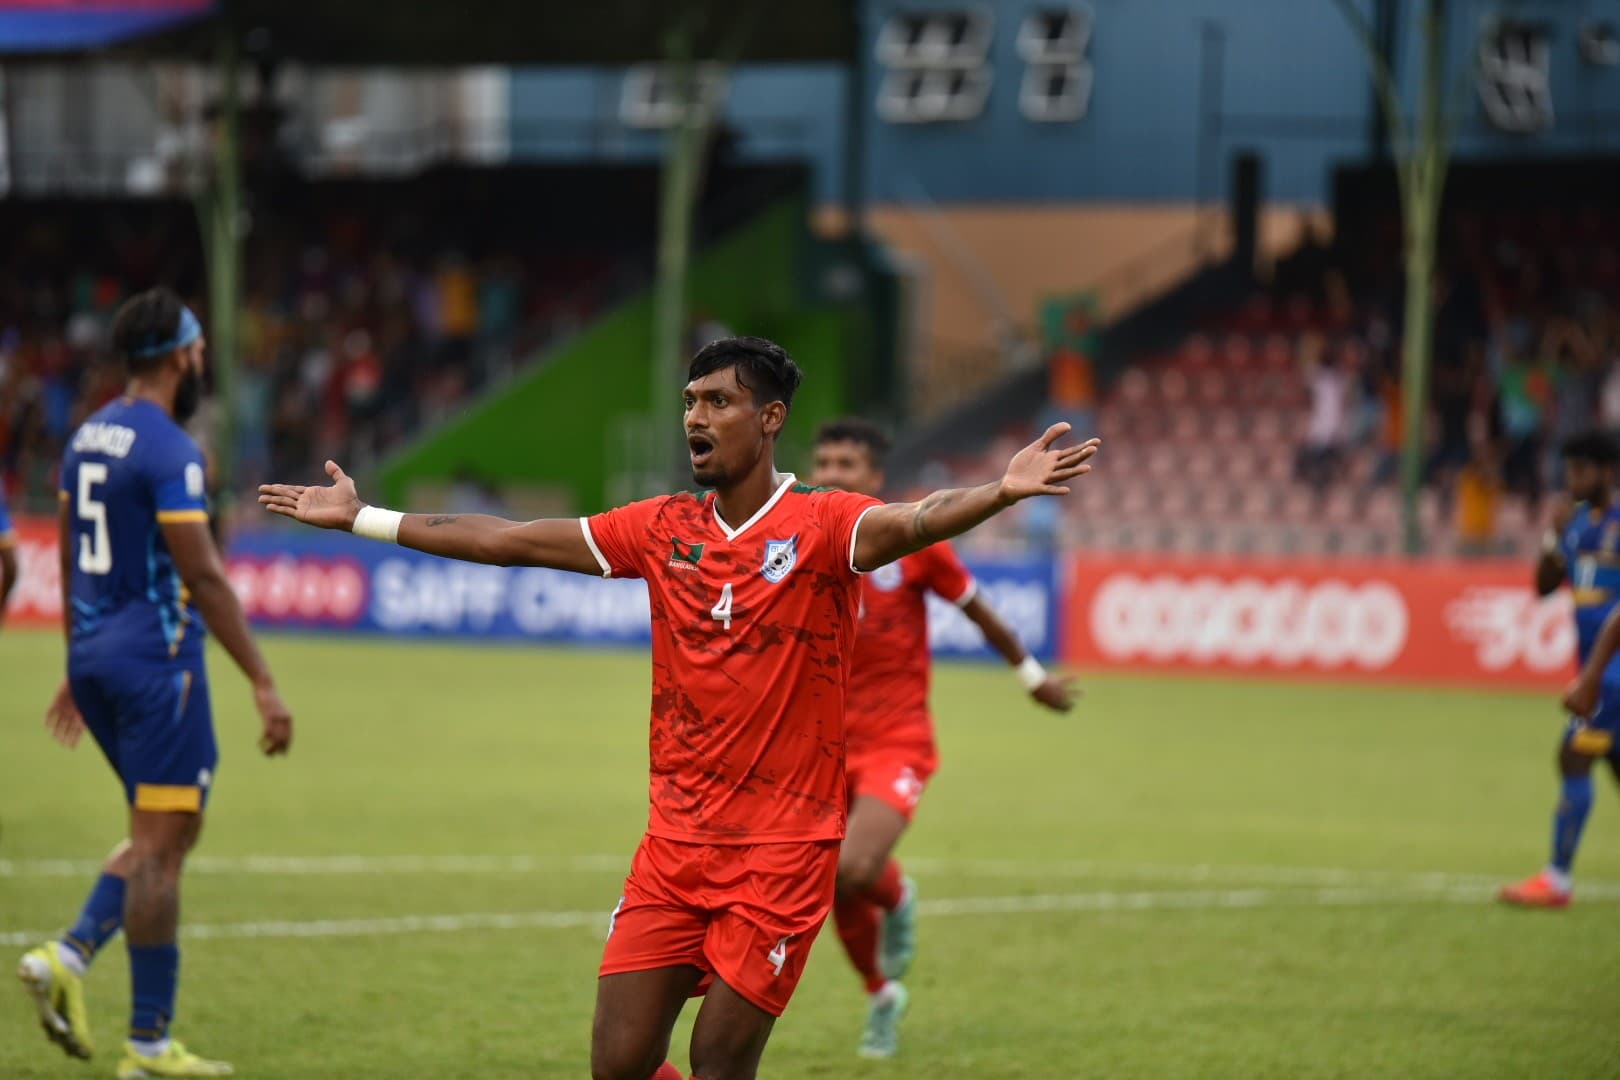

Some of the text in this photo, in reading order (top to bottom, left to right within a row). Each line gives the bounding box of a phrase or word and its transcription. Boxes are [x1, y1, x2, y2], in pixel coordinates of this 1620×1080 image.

[78, 462, 112, 575] 5
[711, 583, 733, 630] 4
[767, 933, 795, 976] 4
